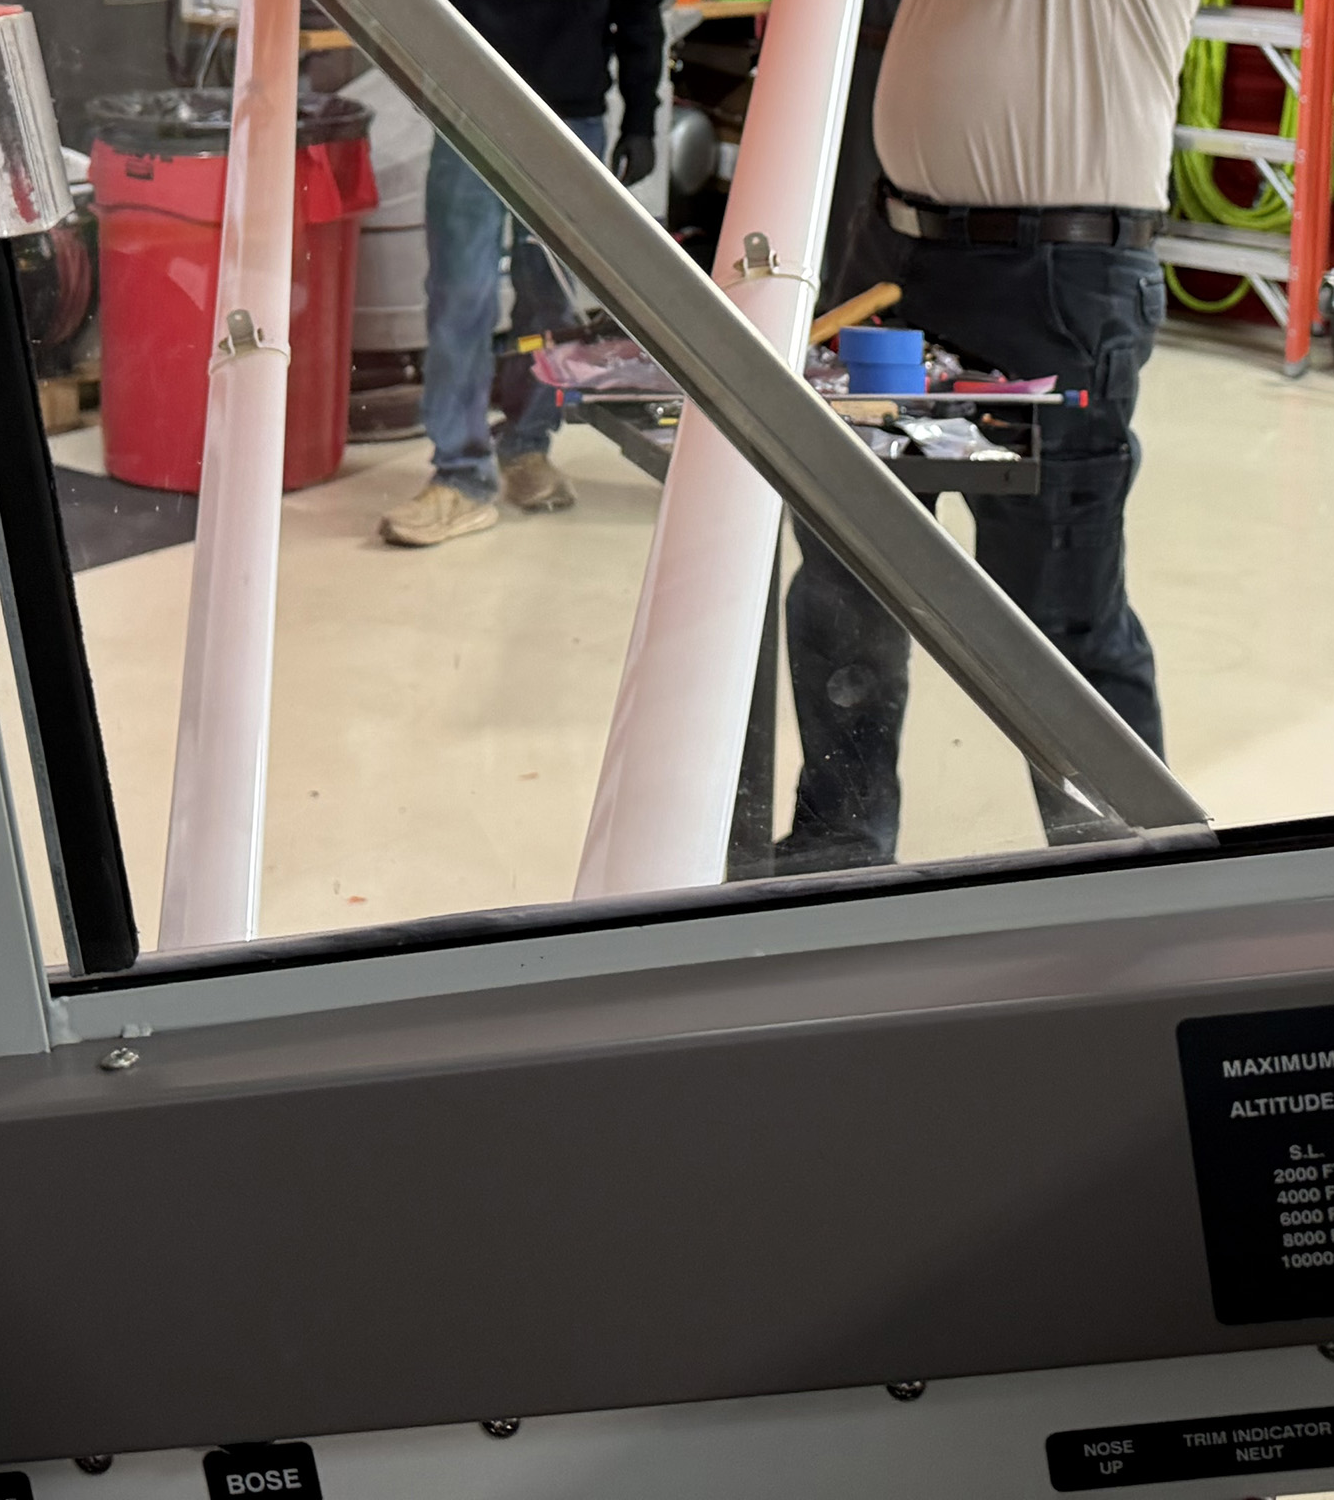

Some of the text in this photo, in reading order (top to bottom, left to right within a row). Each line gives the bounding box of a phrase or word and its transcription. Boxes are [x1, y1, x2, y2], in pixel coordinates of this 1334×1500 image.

[1289, 1143, 1326, 1161] S.L.
[1274, 1165, 1319, 1184] 2000
[1276, 1187, 1321, 1206] 4000
[1279, 1208, 1324, 1227] 6000
[1283, 1230, 1327, 1248] 8000
[1281, 1251, 1334, 1270] 10000
[1183, 1421, 1332, 1448] TRIM INDICATOR
[1084, 1438, 1134, 1458] NOSE
[1236, 1444, 1284, 1463] NEUT
[1100, 1458, 1124, 1476] UP
[225, 1466, 302, 1495] BOSE
